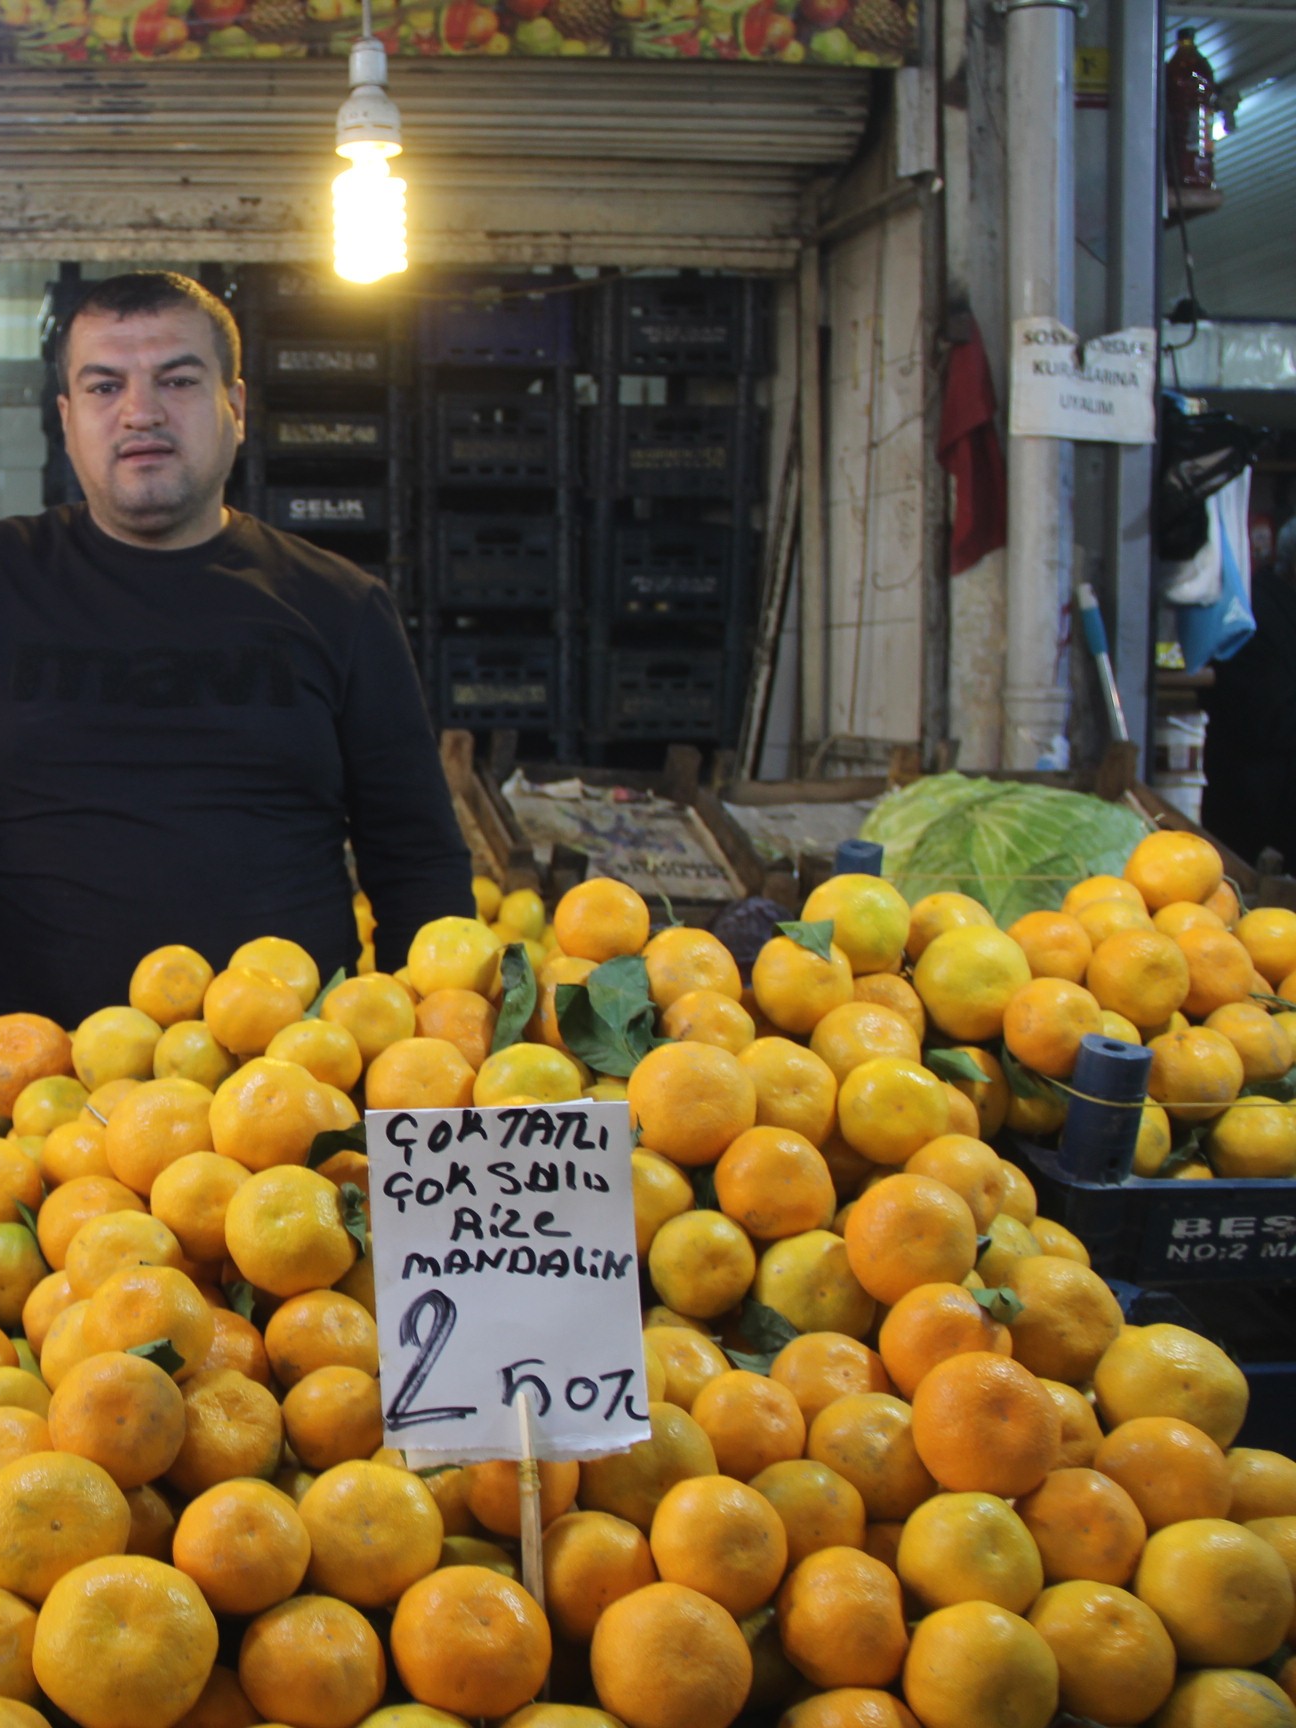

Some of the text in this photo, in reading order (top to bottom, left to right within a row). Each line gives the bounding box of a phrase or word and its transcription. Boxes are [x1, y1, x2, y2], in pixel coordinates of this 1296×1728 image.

[385, 1109, 488, 1166] ÇOK
[383, 1161, 477, 1213] ÇOK
[384, 1288, 478, 1432] 2
